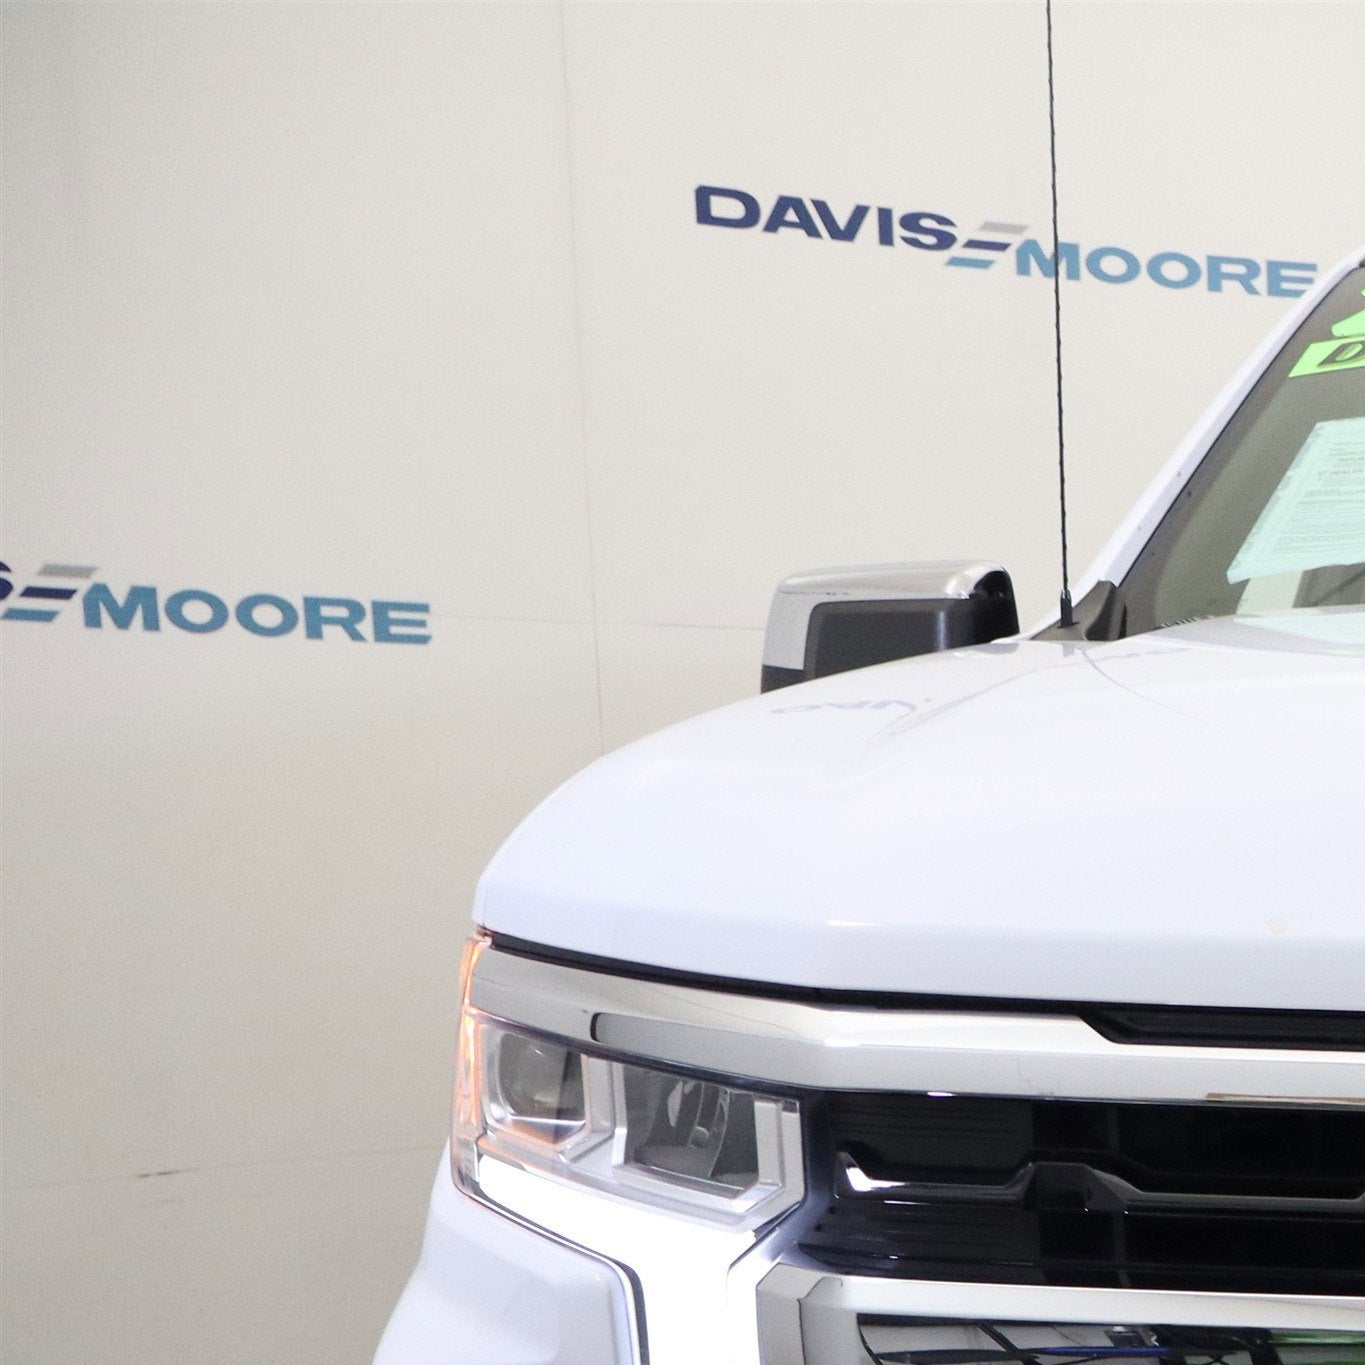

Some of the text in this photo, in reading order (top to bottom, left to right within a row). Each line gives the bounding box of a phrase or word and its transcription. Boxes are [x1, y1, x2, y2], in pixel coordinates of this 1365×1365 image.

[695, 185, 1319, 299] DAVIS MOORE
[82, 582, 433, 645] MOORE
